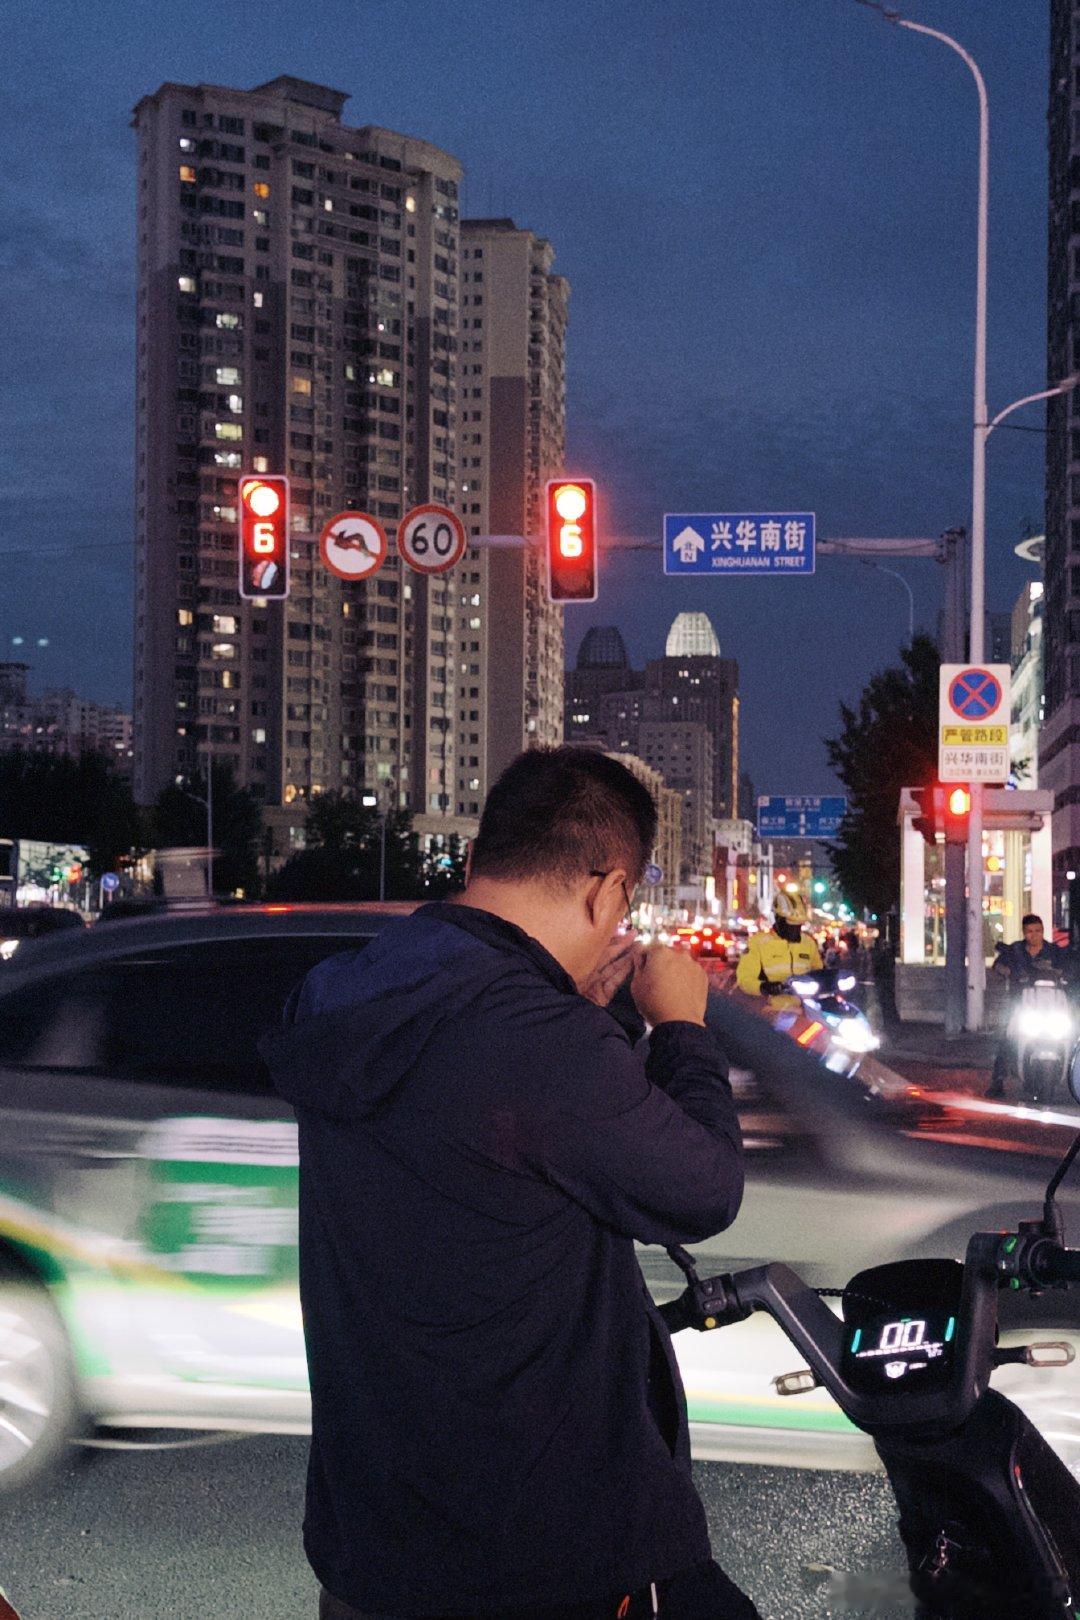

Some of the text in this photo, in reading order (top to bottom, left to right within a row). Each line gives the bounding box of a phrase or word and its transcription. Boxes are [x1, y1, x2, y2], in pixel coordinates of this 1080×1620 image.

[253, 523, 275, 553] 6
[411, 523, 453, 555] 60
[559, 524, 583, 557] 6
[711, 520, 806, 552] 兴华南街
[684, 552, 693, 560] N
[712, 556, 806, 567] XINGHUANAN STREET
[945, 752, 1003, 765] 兴华南街
[880, 1320, 926, 1350] 00
